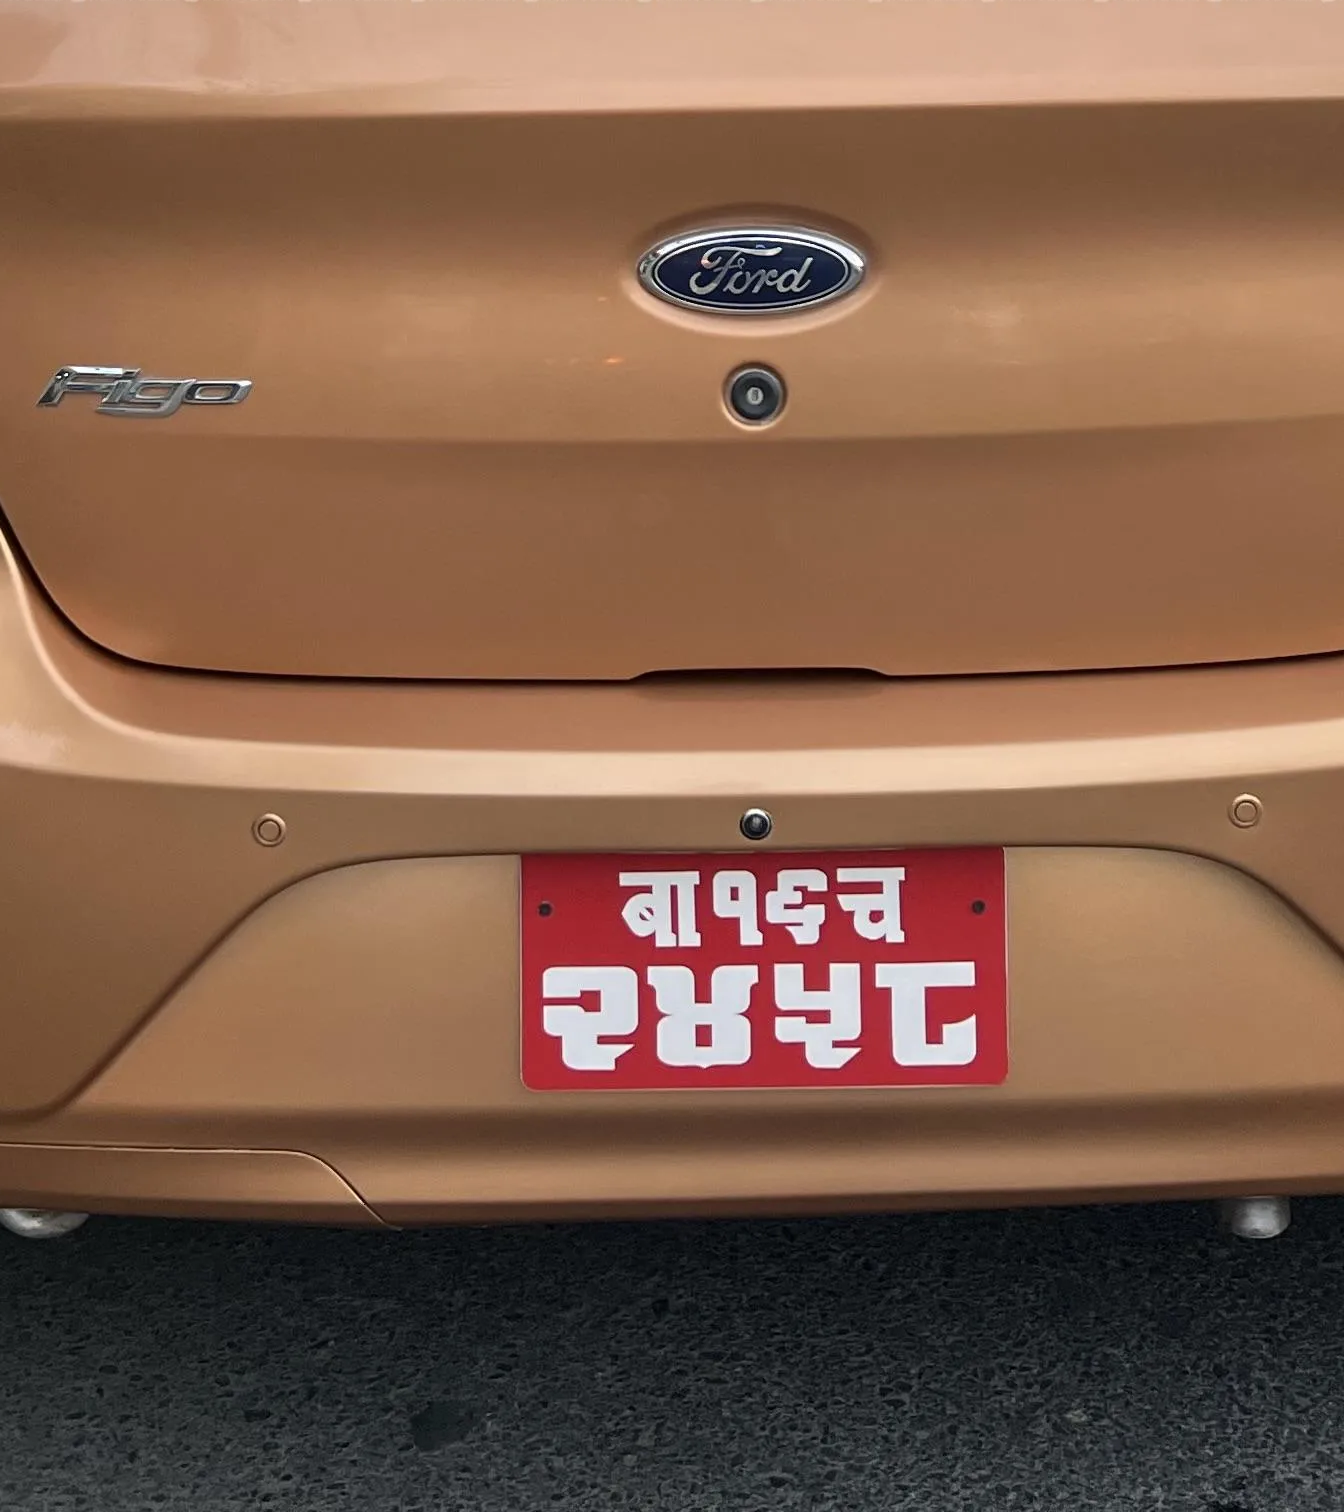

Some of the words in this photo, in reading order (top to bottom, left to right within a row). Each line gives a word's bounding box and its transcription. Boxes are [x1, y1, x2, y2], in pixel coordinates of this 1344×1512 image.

[689, 245, 814, 296] Ford
[35, 364, 253, 419] Figo
[542, 961, 978, 1071] २४५८
